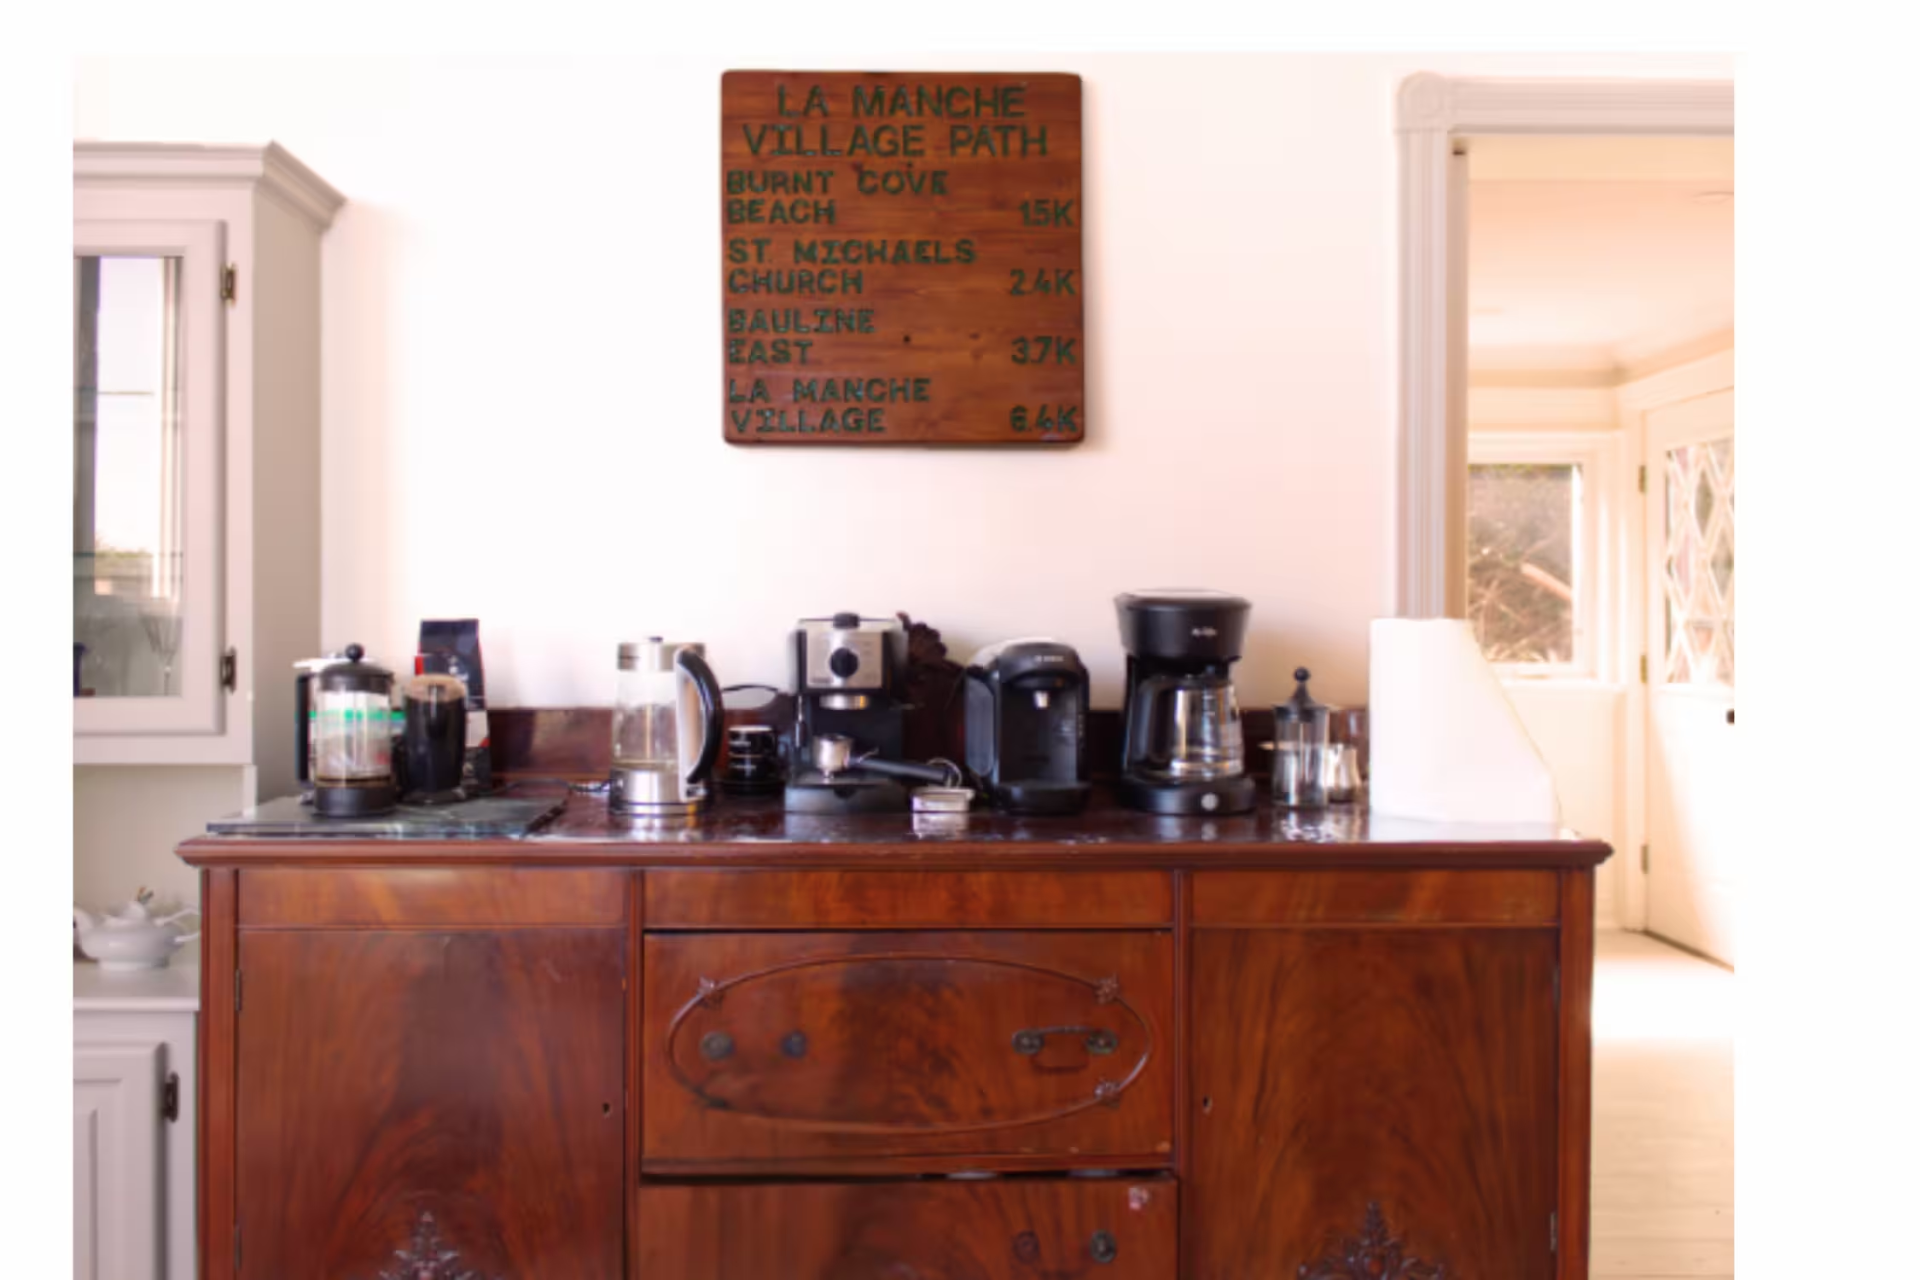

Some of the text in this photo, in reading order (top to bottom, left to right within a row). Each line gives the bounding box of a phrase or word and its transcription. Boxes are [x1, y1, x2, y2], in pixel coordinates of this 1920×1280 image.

[777, 84, 1027, 118] LA MANCHE
[742, 124, 1048, 157] VILLAGE PATH
[727, 170, 949, 195] BURNT COVE
[727, 199, 836, 224] BEACH
[794, 238, 976, 265] MICHAELS
[728, 267, 863, 294] CHURCH
[728, 308, 876, 334] BAULINE
[728, 338, 813, 365] EAST
[729, 378, 931, 402] LA MANCHE
[731, 408, 886, 433] VILLAGE
